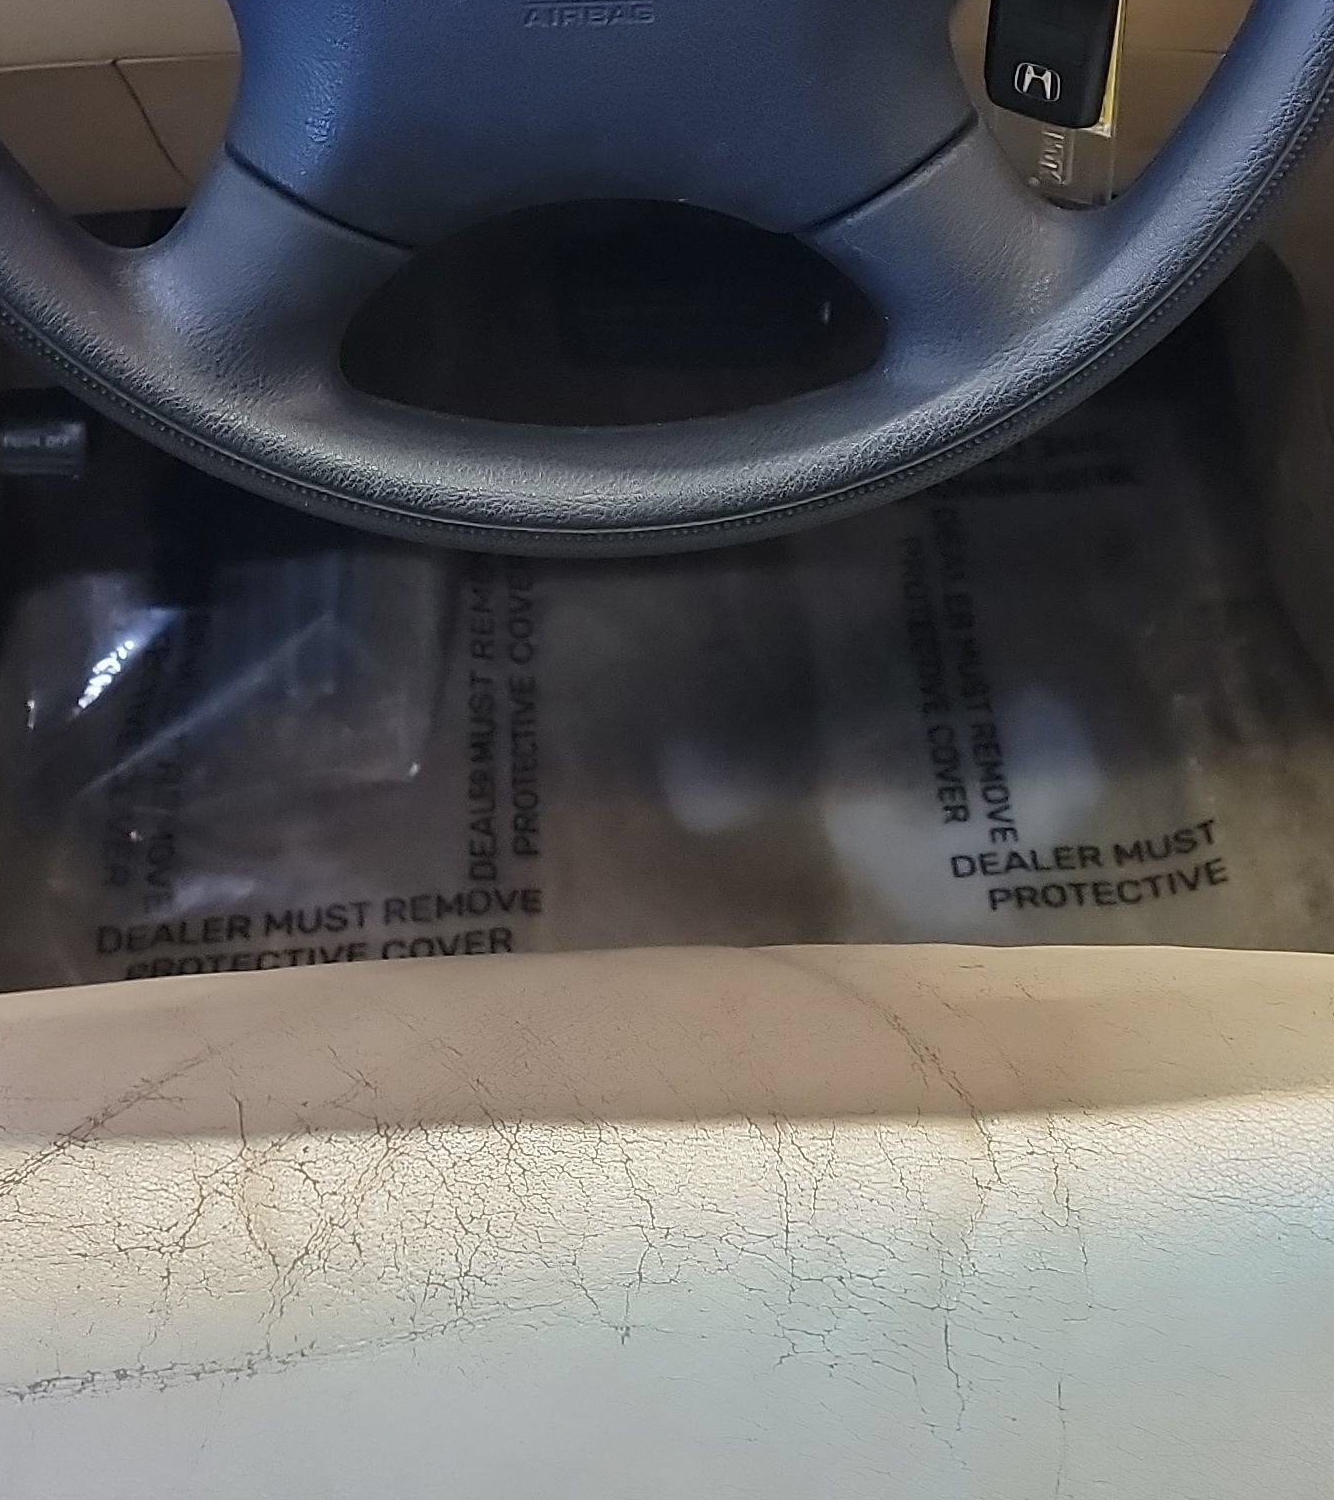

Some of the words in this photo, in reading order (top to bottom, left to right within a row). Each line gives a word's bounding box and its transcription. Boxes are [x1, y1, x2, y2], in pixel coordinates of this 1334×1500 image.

[927, 723, 971, 825] COVER
[969, 720, 1020, 844] REMOVE
[950, 843, 1103, 879] DEALER
[1113, 818, 1217, 867] MUST
[987, 856, 1231, 912] PROTECTIVE
[96, 914, 251, 957] DEALER
[263, 900, 371, 937] MUST
[383, 888, 545, 925] REMOVE
[380, 926, 514, 961] COVER
